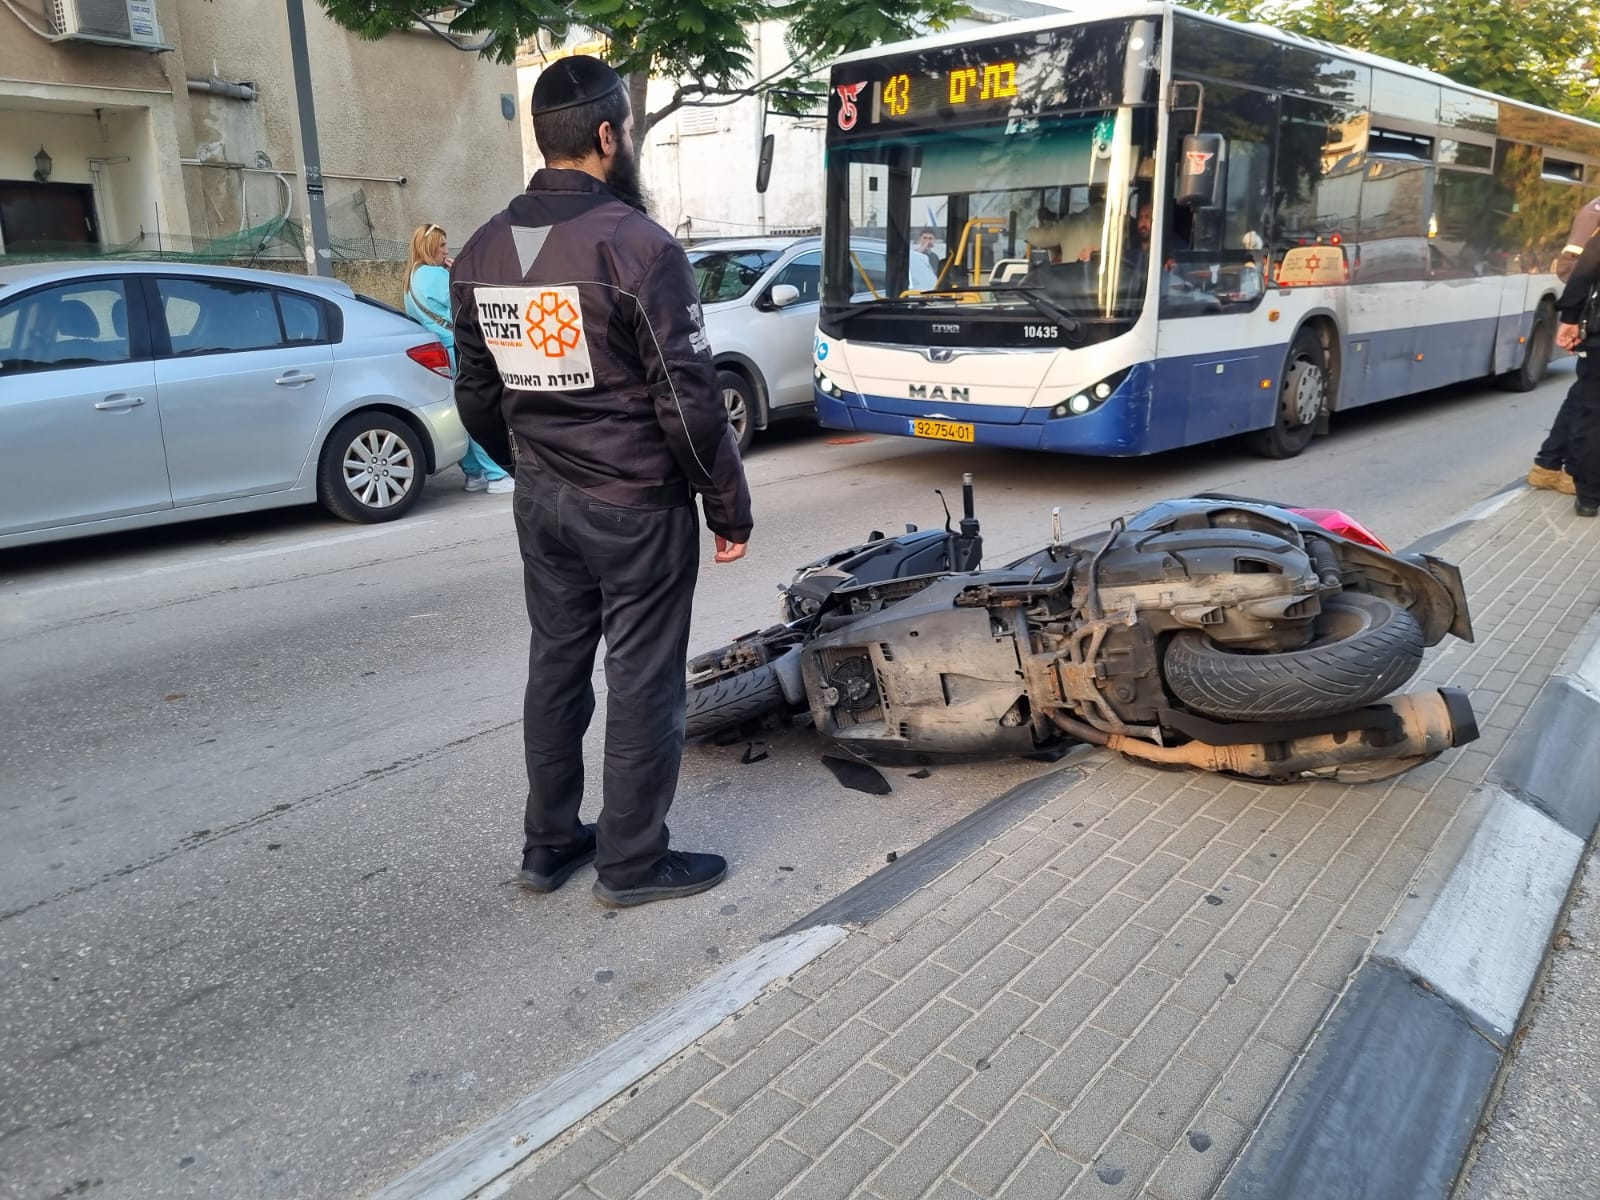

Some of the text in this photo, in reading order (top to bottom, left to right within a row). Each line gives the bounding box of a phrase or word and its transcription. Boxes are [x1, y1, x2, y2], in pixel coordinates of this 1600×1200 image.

[949, 63, 1018, 103] בת ים
[883, 75, 910, 116] 43
[479, 303, 519, 319] איחוד
[482, 321, 521, 339] הצלה
[1024, 325, 1058, 338] 10435
[547, 372, 589, 386] יחידת
[909, 383, 970, 402] MAN
